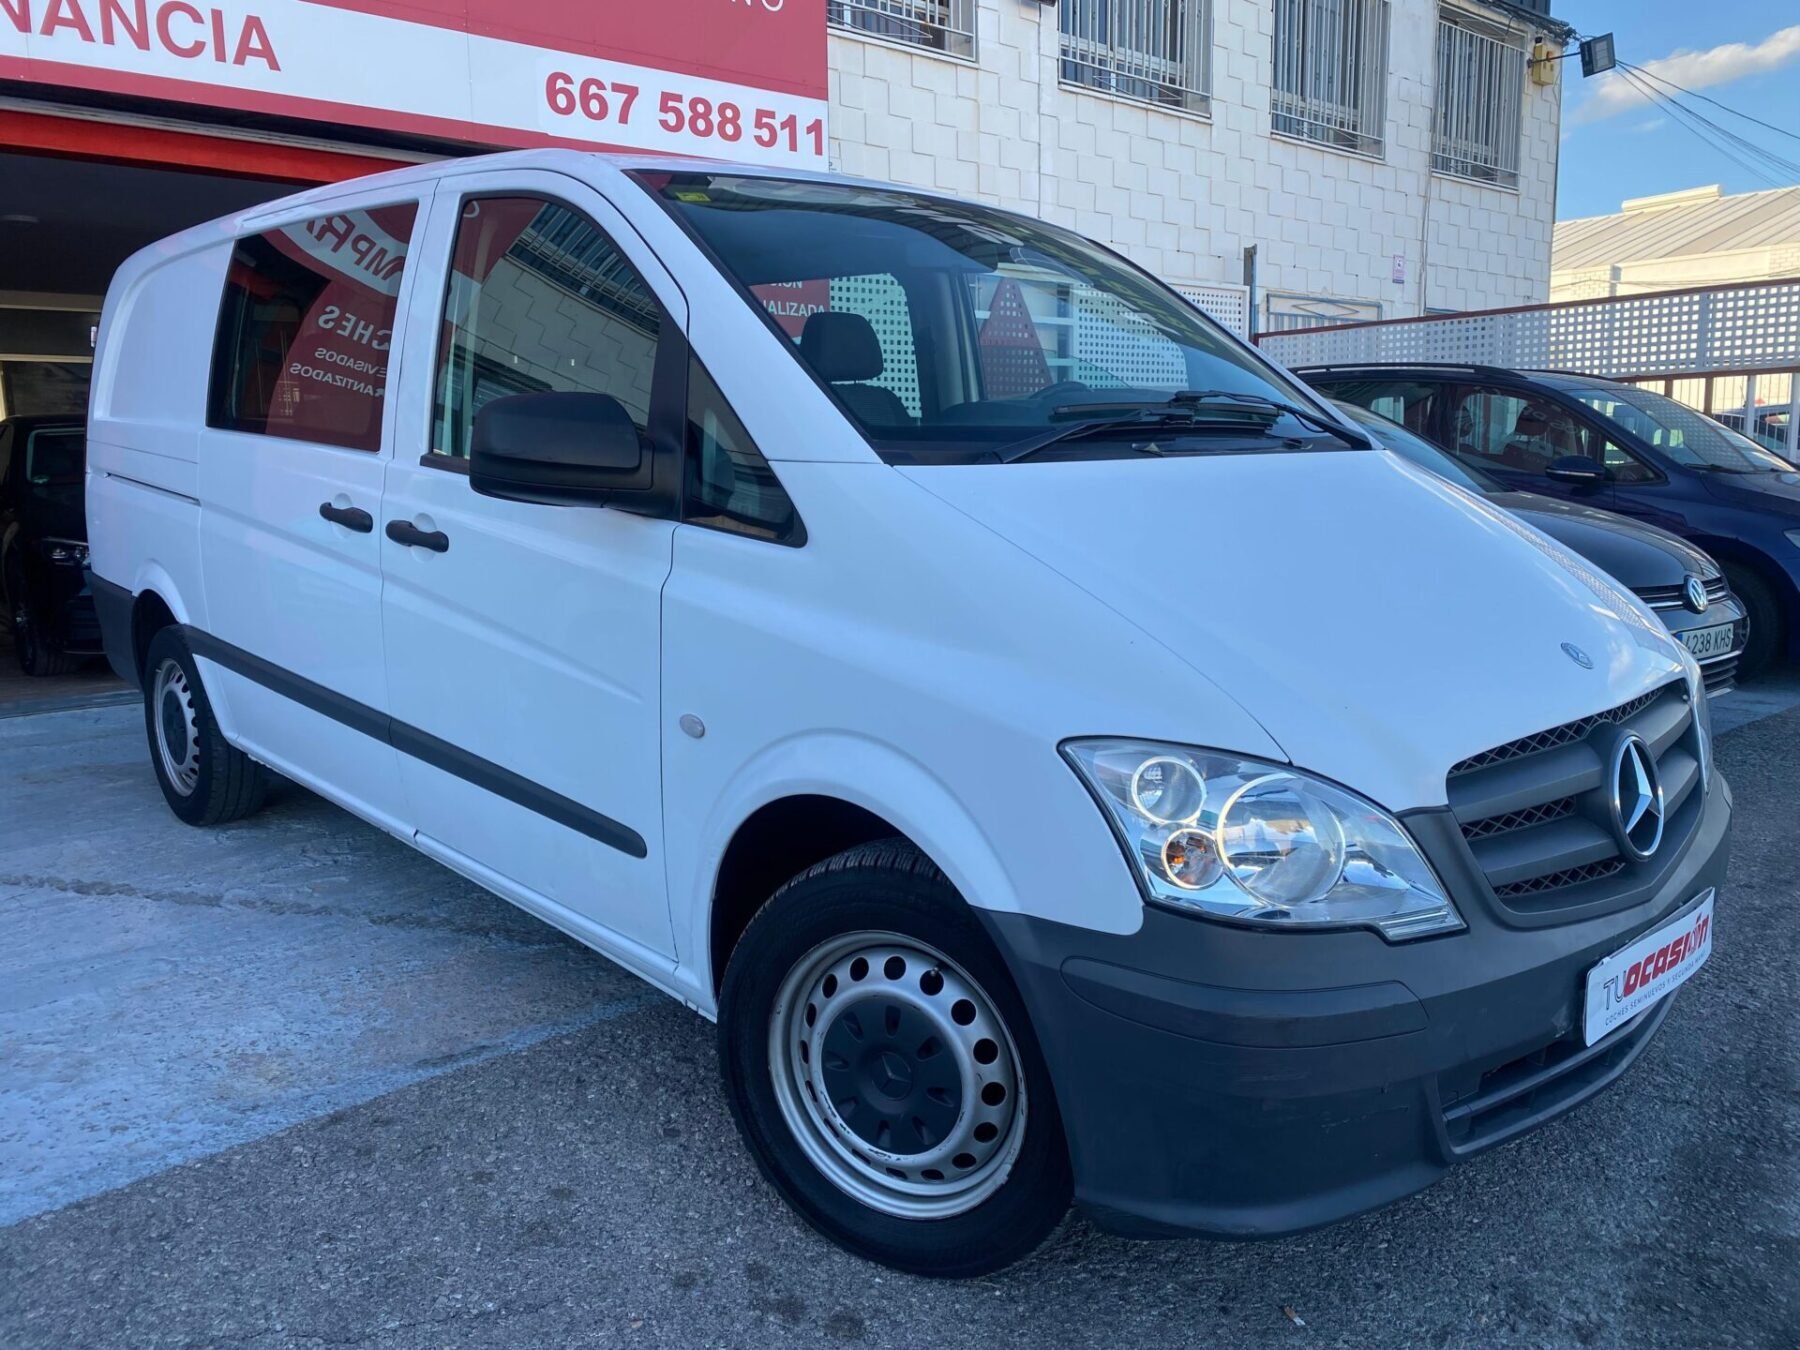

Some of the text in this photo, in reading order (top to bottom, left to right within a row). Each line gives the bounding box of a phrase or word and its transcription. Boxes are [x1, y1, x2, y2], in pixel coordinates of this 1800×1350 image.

[545, 71, 823, 156] 667 588 511
[1713, 628, 1731, 651] KHS
